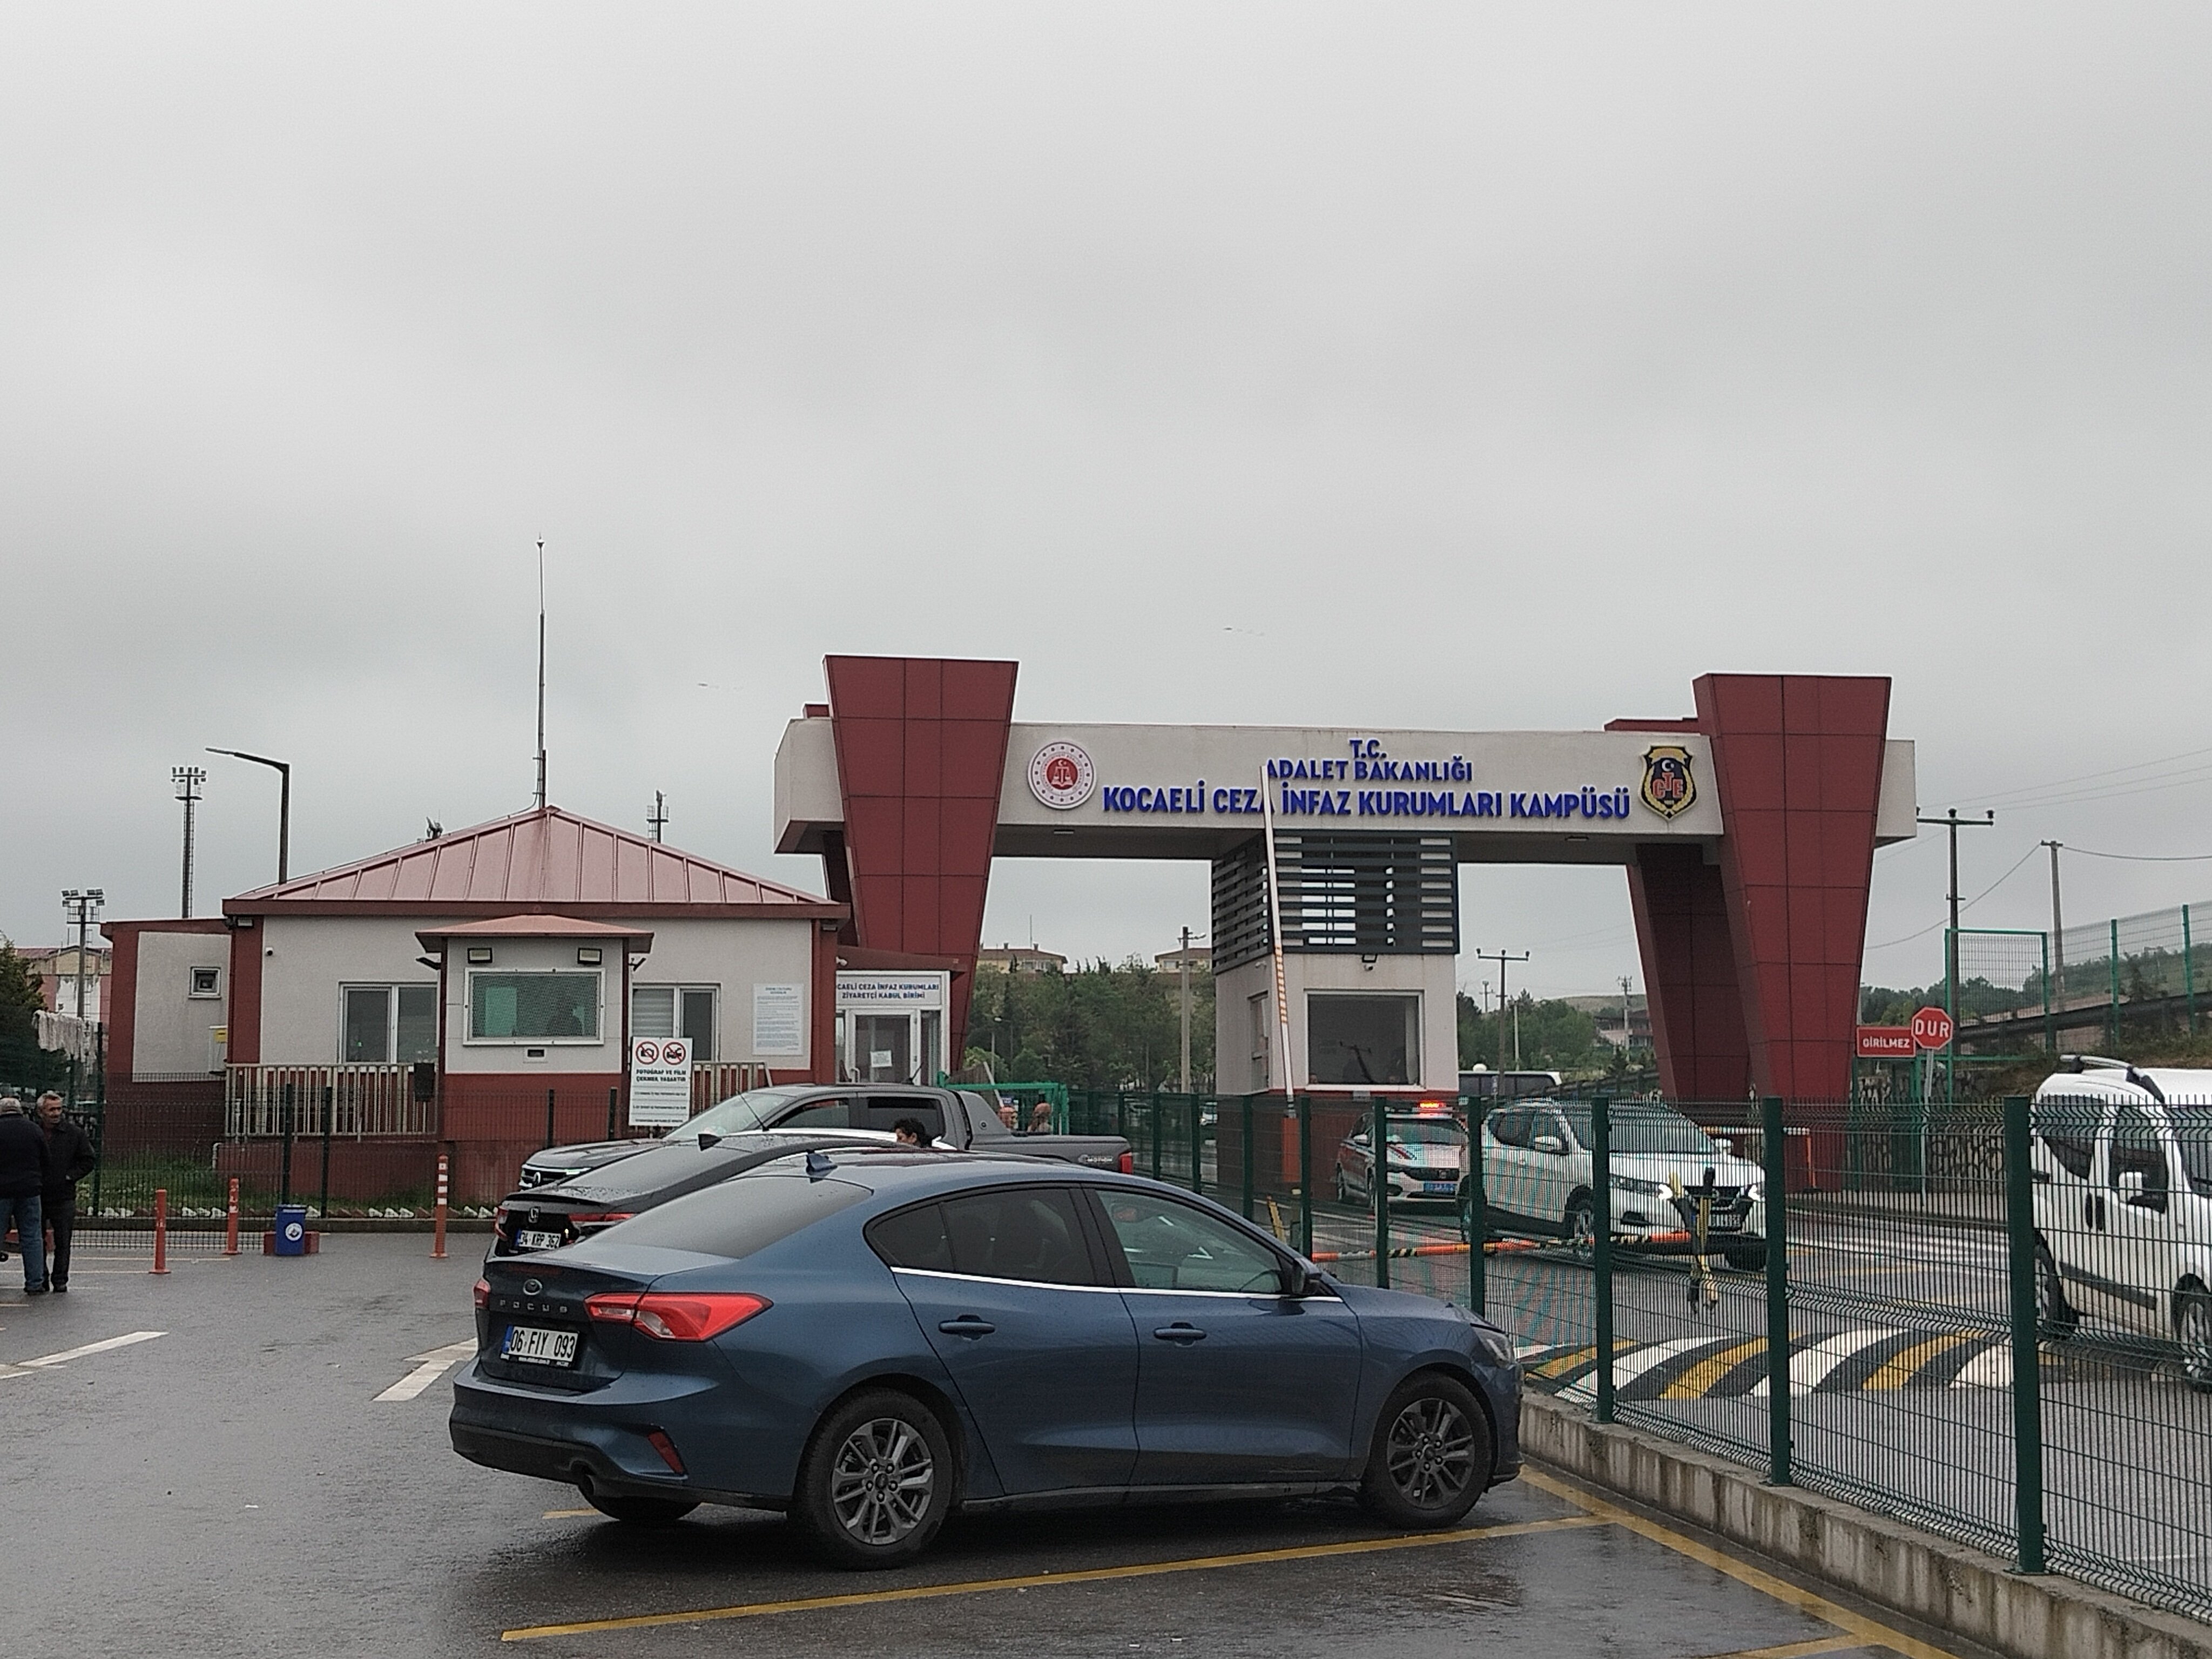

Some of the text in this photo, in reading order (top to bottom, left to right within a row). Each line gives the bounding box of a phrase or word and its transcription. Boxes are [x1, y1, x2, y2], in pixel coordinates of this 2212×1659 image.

[1350, 739, 1387, 758] T.C.
[1267, 755, 1472, 781] ADALET BAKANLIĞI
[1103, 780, 1205, 812] KOCAELİ
[1282, 781, 1351, 815] İNFAZ
[1358, 791, 1502, 817] KURUMLARI
[1510, 786, 1630, 818] KAMPÜSÜ
[878, 982, 897, 990] İNFAZ
[1915, 1019, 1949, 1038] DUR
[1863, 1035, 1910, 1048] GİRİLMEZ
[510, 1330, 576, 1358] 06 FIY 093
